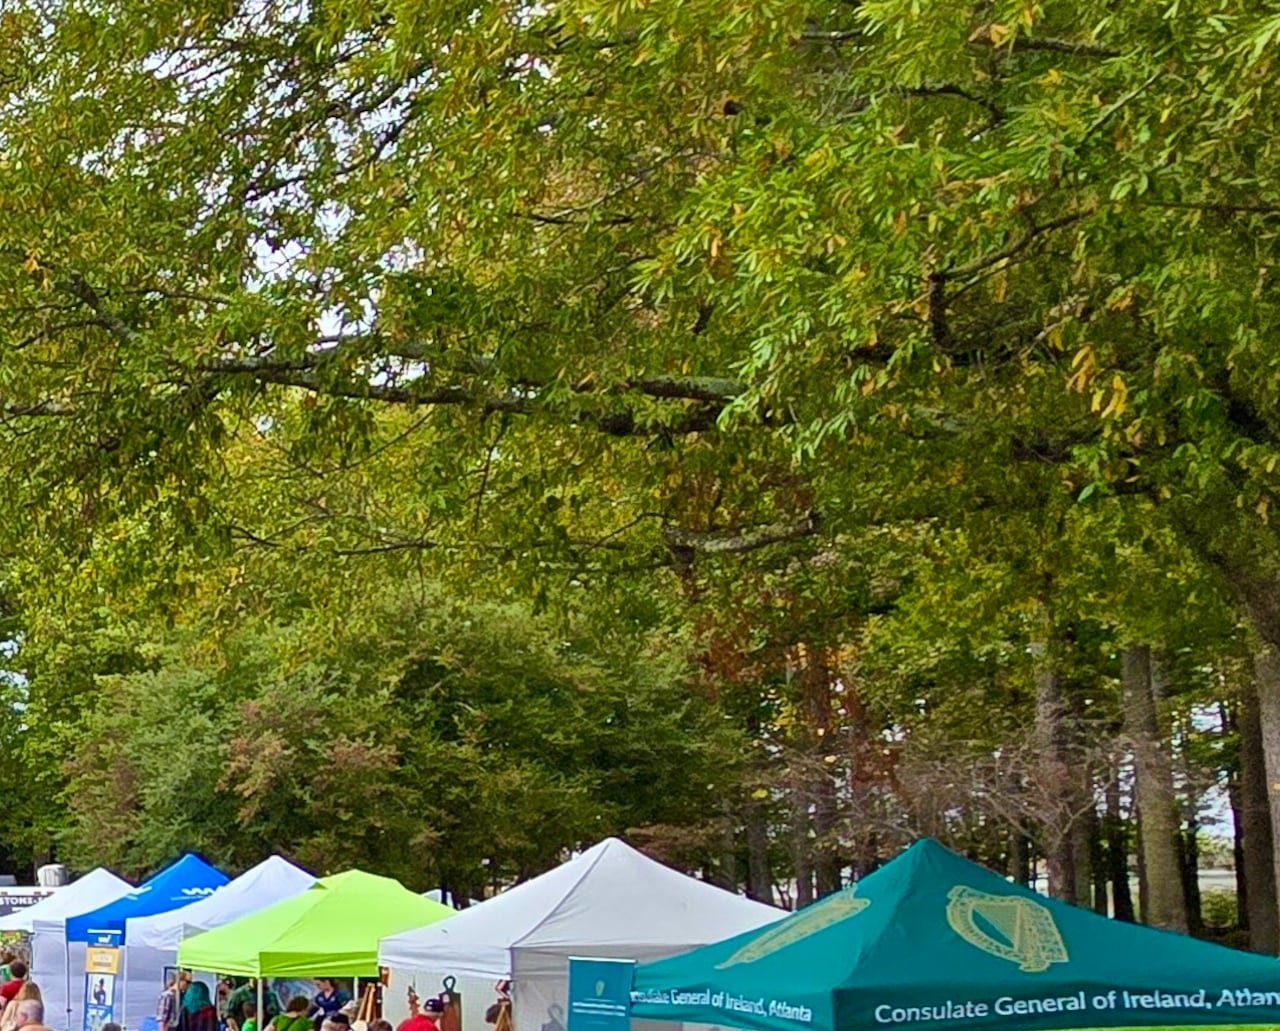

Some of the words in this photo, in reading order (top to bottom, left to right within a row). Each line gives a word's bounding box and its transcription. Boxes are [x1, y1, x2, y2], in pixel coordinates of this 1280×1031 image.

[670, 988, 710, 1005] General
[711, 991, 725, 1007] of
[725, 992, 768, 1017] Ireland,
[768, 999, 813, 1022] Atlanta
[874, 1000, 989, 1024] Consulate
[994, 990, 1087, 1016] General
[1092, 989, 1117, 1010] of
[1122, 988, 1213, 1010] Ireland,
[1215, 987, 1280, 1007] Atlan
